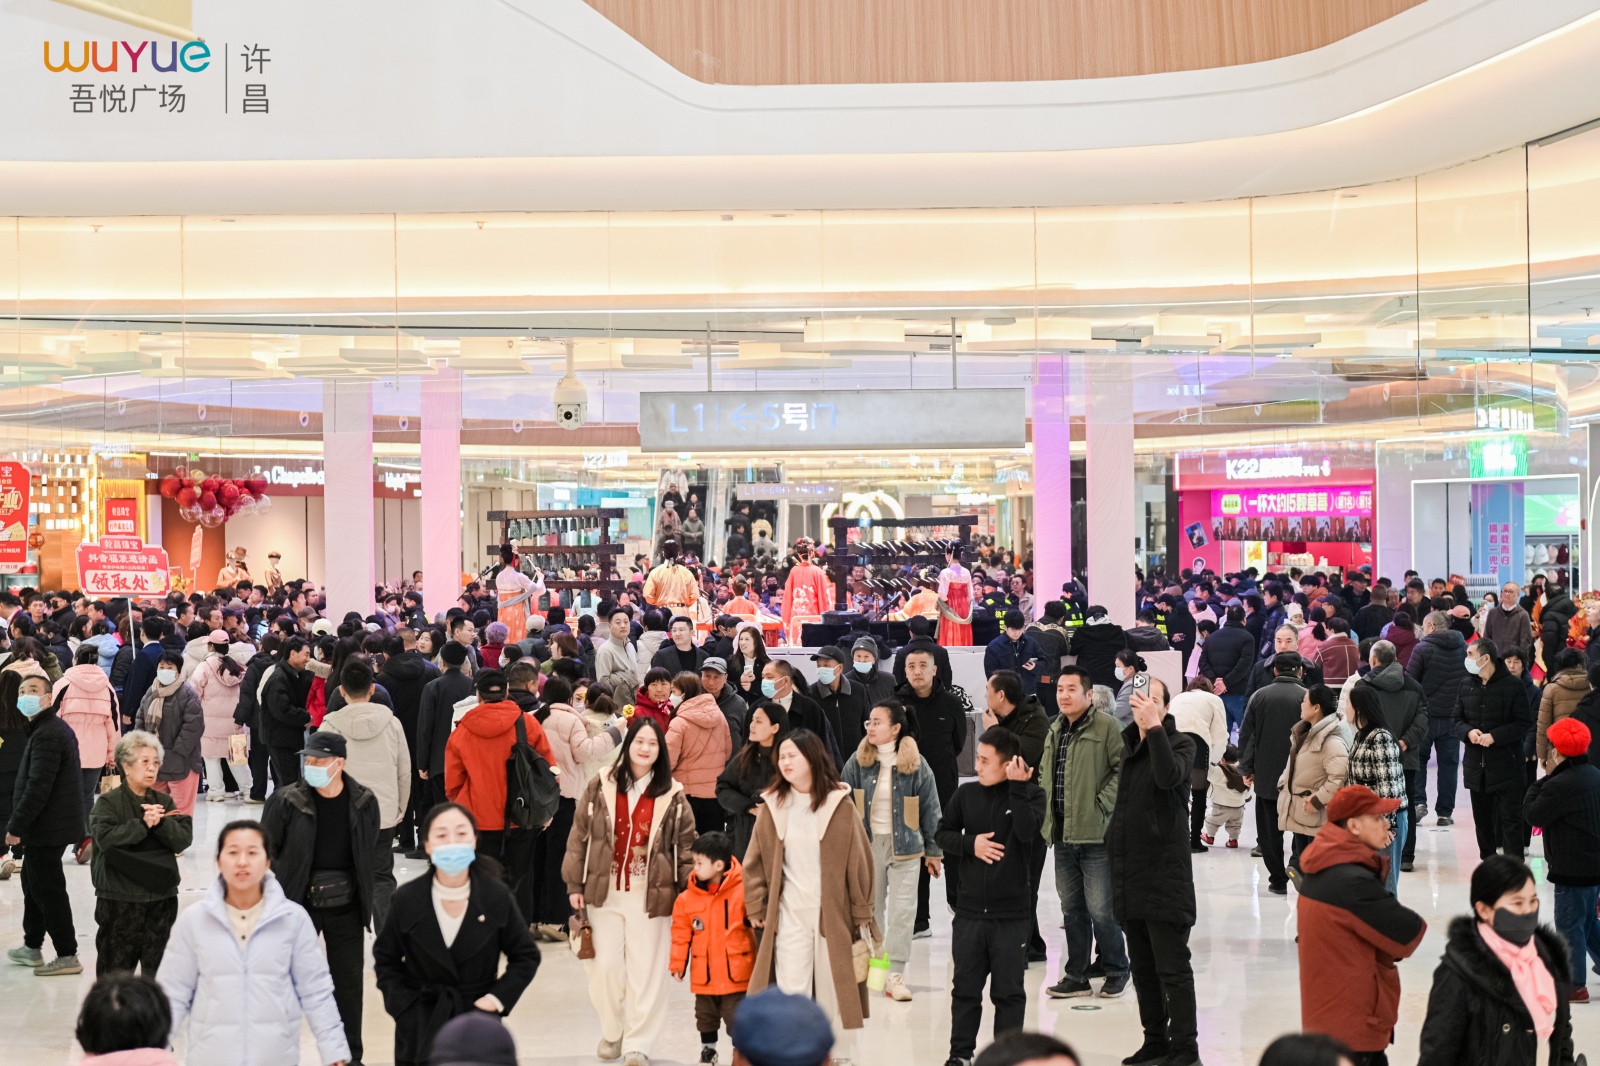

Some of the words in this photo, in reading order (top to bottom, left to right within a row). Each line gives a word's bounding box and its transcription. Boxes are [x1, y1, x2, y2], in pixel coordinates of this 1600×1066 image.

[669, 402, 705, 433] L1
[762, 402, 837, 432] 5号门
[1501, 523, 1510, 566] 满载而归
[91, 572, 149, 591] 领取处
